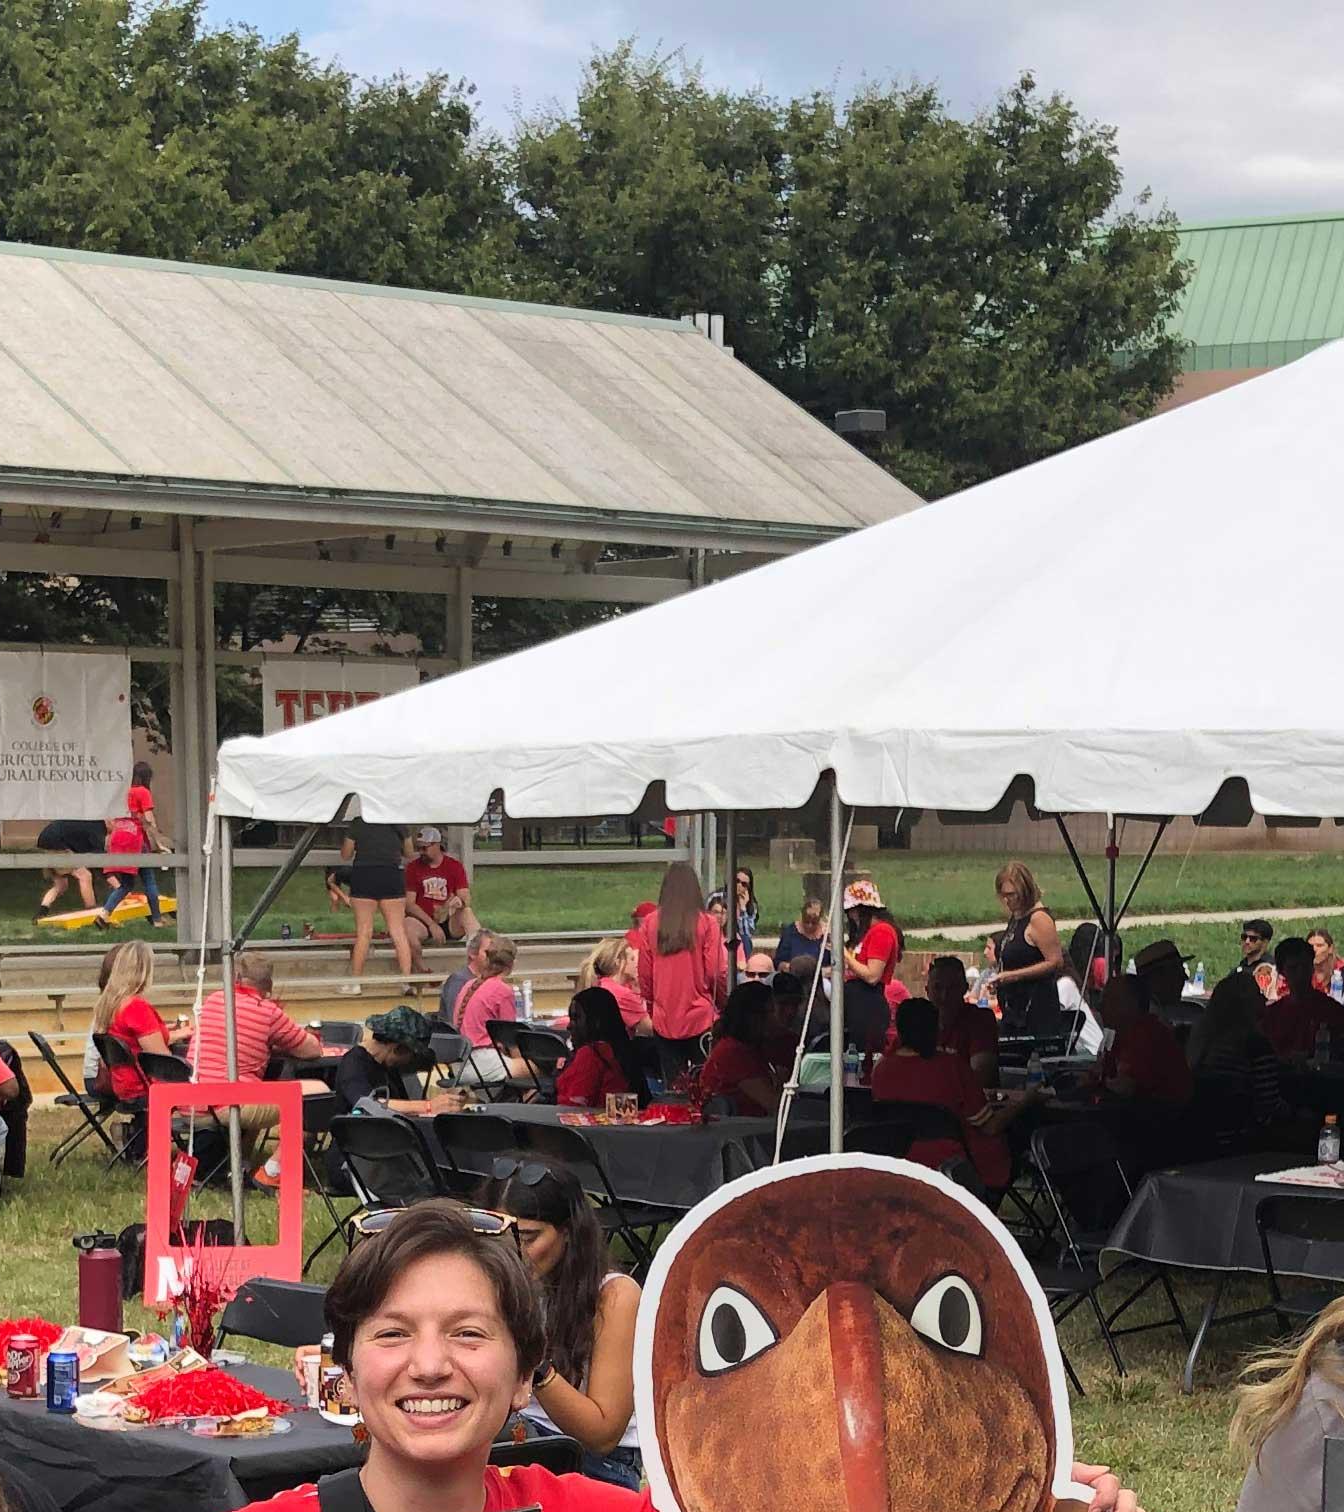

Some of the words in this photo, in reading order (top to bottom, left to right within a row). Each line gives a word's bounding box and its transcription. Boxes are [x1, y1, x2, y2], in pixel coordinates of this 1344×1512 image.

[11, 740, 60, 751] COLLEGE
[62, 741, 79, 751] OF
[89, 755, 97, 767] &
[37, 769, 124, 783] RESOURCES
